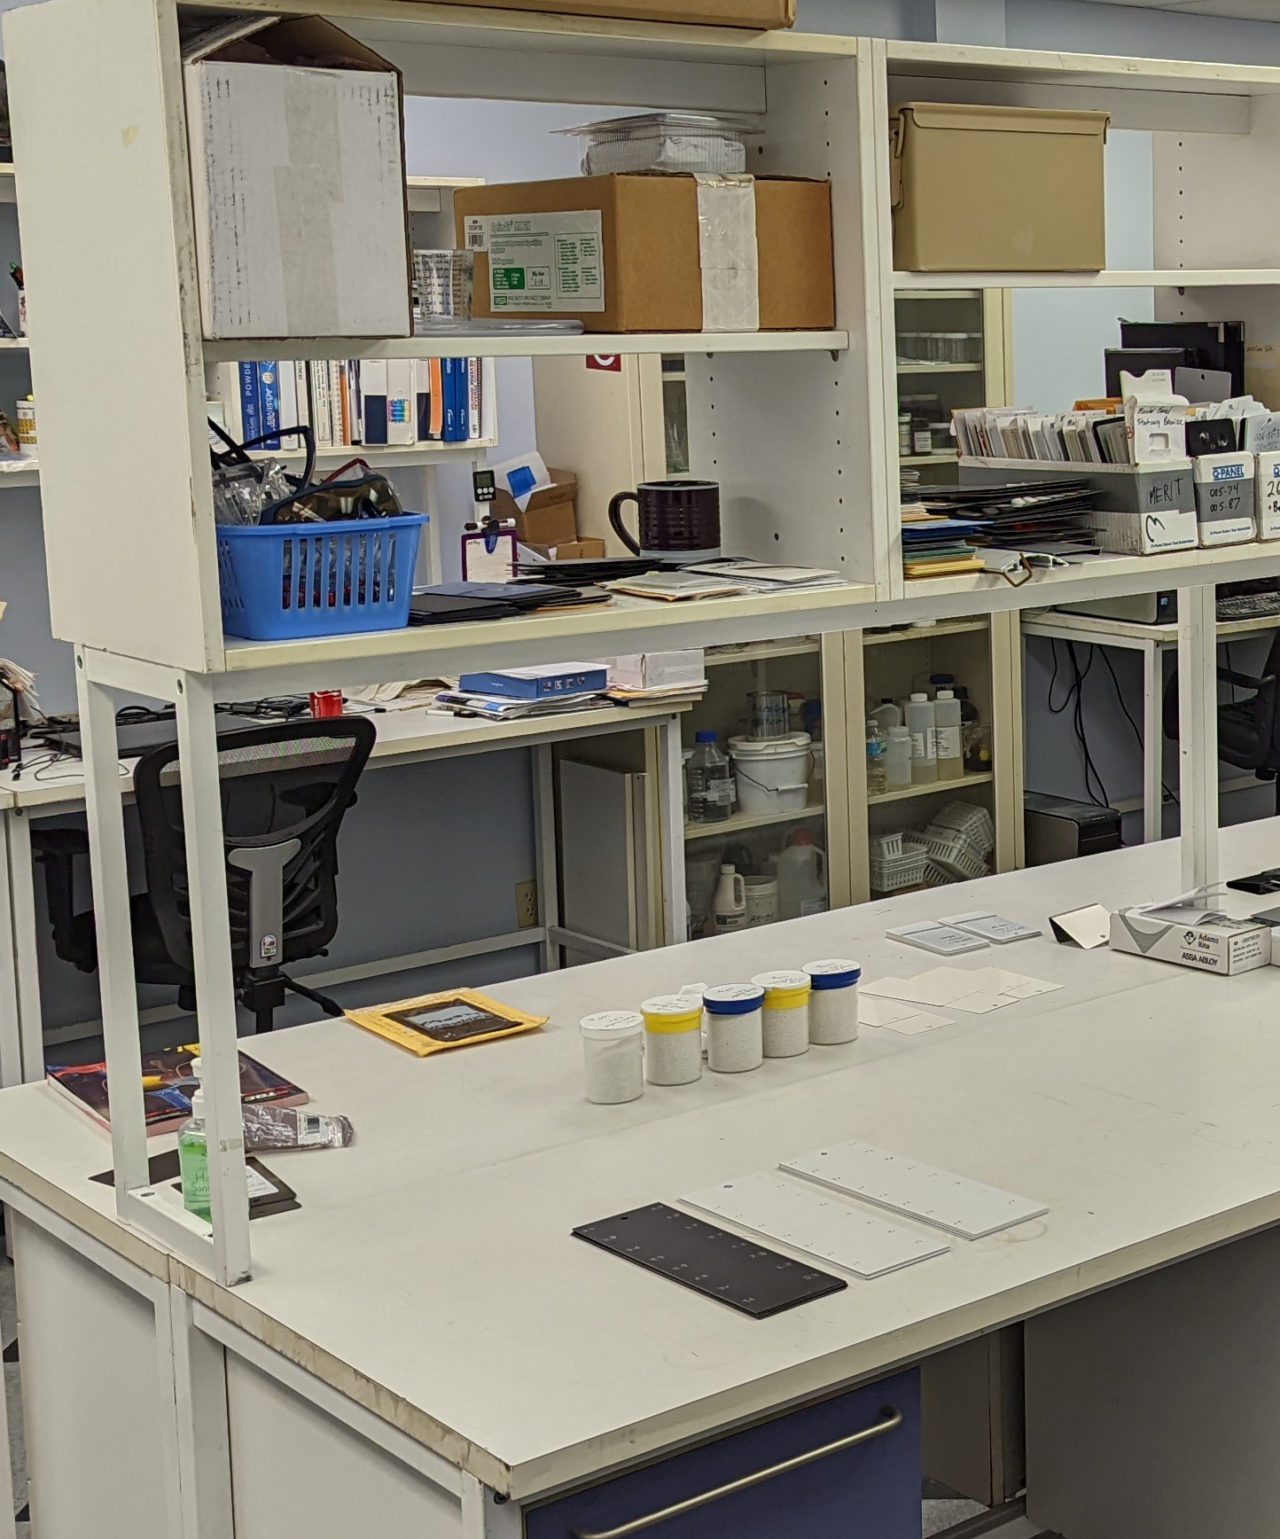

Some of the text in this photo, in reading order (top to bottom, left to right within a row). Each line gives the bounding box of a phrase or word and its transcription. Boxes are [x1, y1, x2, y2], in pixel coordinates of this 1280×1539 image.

[245, 360, 253, 396] POWDE
[1212, 465, 1244, 479] Q-PANEL
[1149, 477, 1184, 504] MERIT
[1181, 952, 1219, 966] ASSA ABLOY
